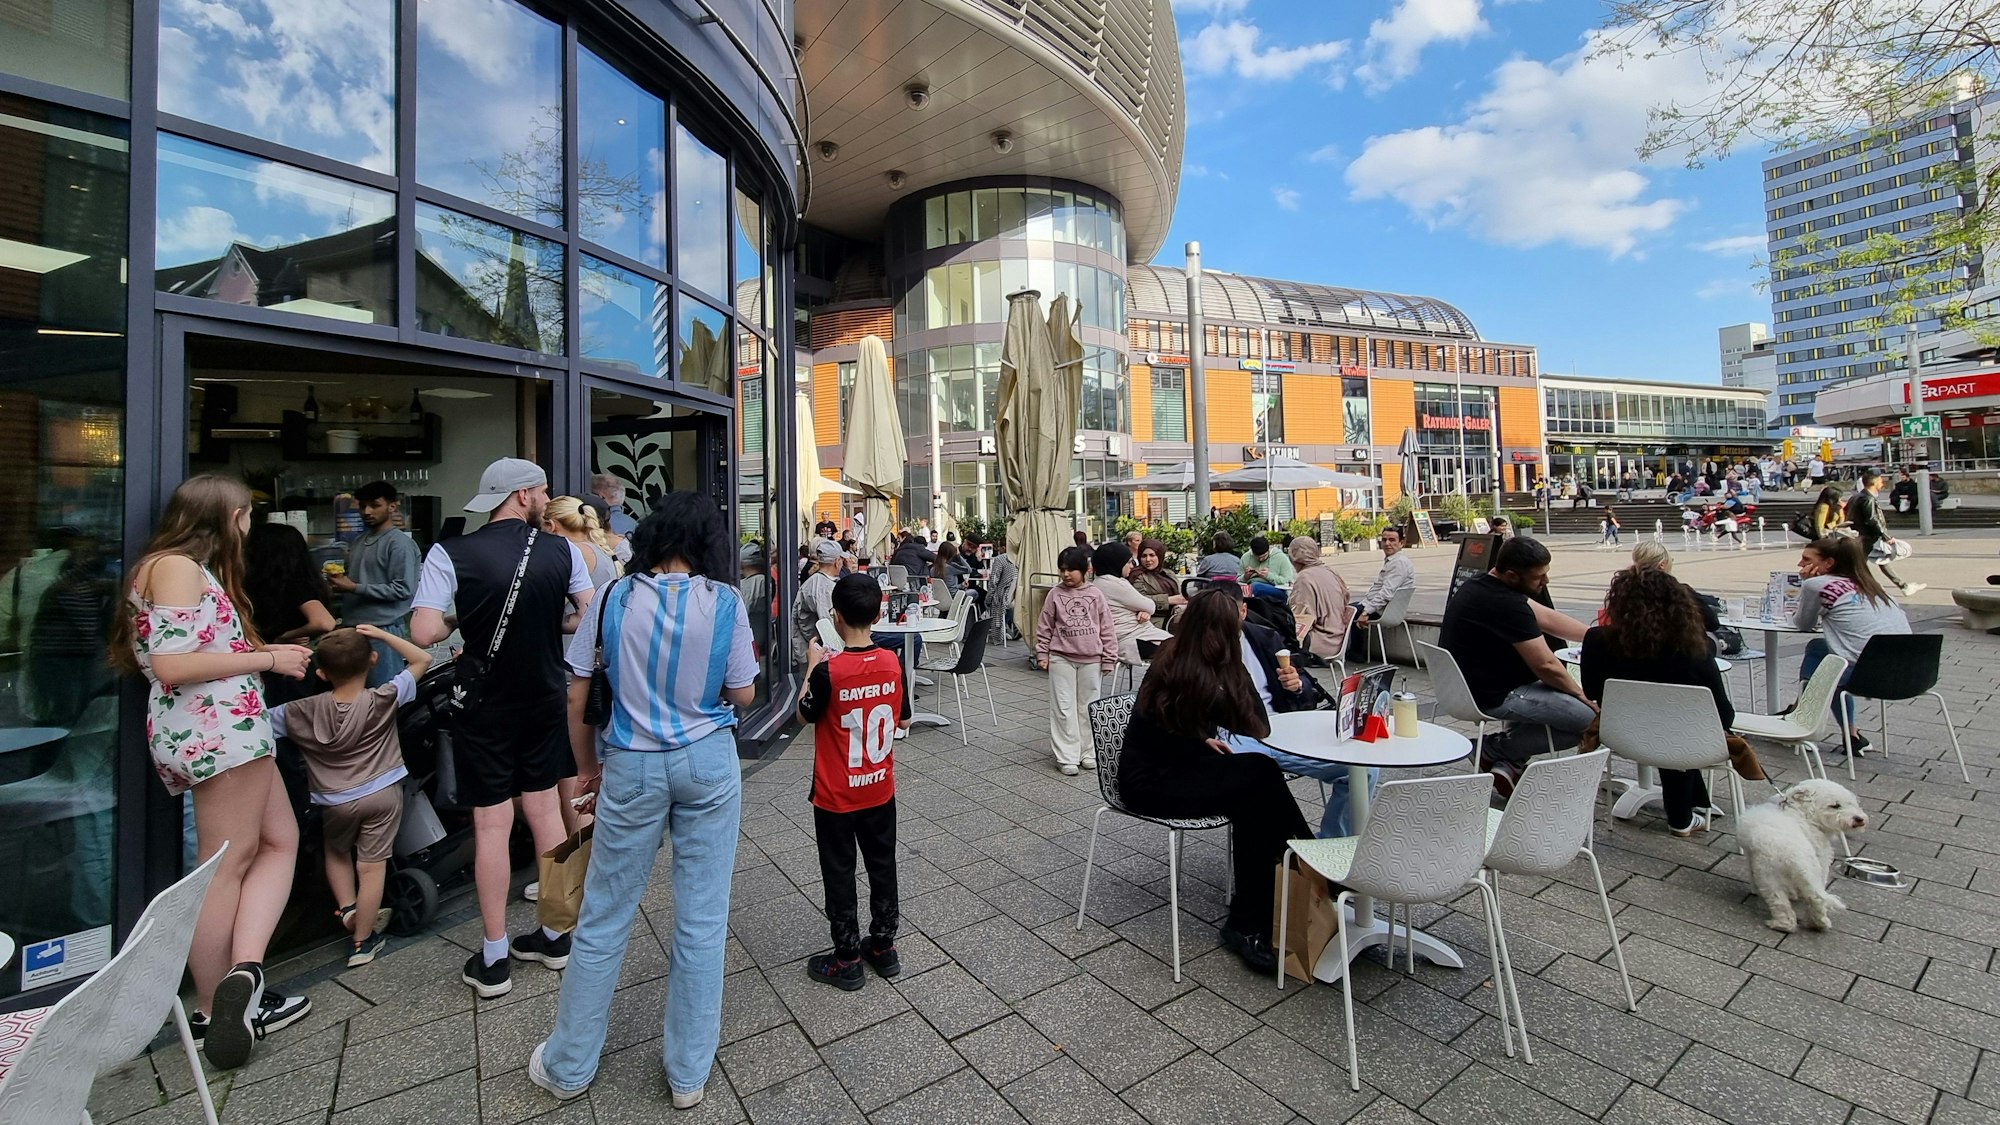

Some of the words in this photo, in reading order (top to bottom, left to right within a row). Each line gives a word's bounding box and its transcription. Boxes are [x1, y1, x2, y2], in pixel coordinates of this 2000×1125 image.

[1909, 382, 1976, 398] ERPART
[1422, 413, 1491, 431] RATHAUS-GALER
[518, 555, 529, 578] adidas
[507, 591, 518, 614] adidas
[493, 628, 506, 651] adidas
[840, 685, 880, 701] BAYER
[882, 681, 896, 695] 04
[841, 704, 894, 768] 10
[849, 769, 886, 787] WIRTZ
